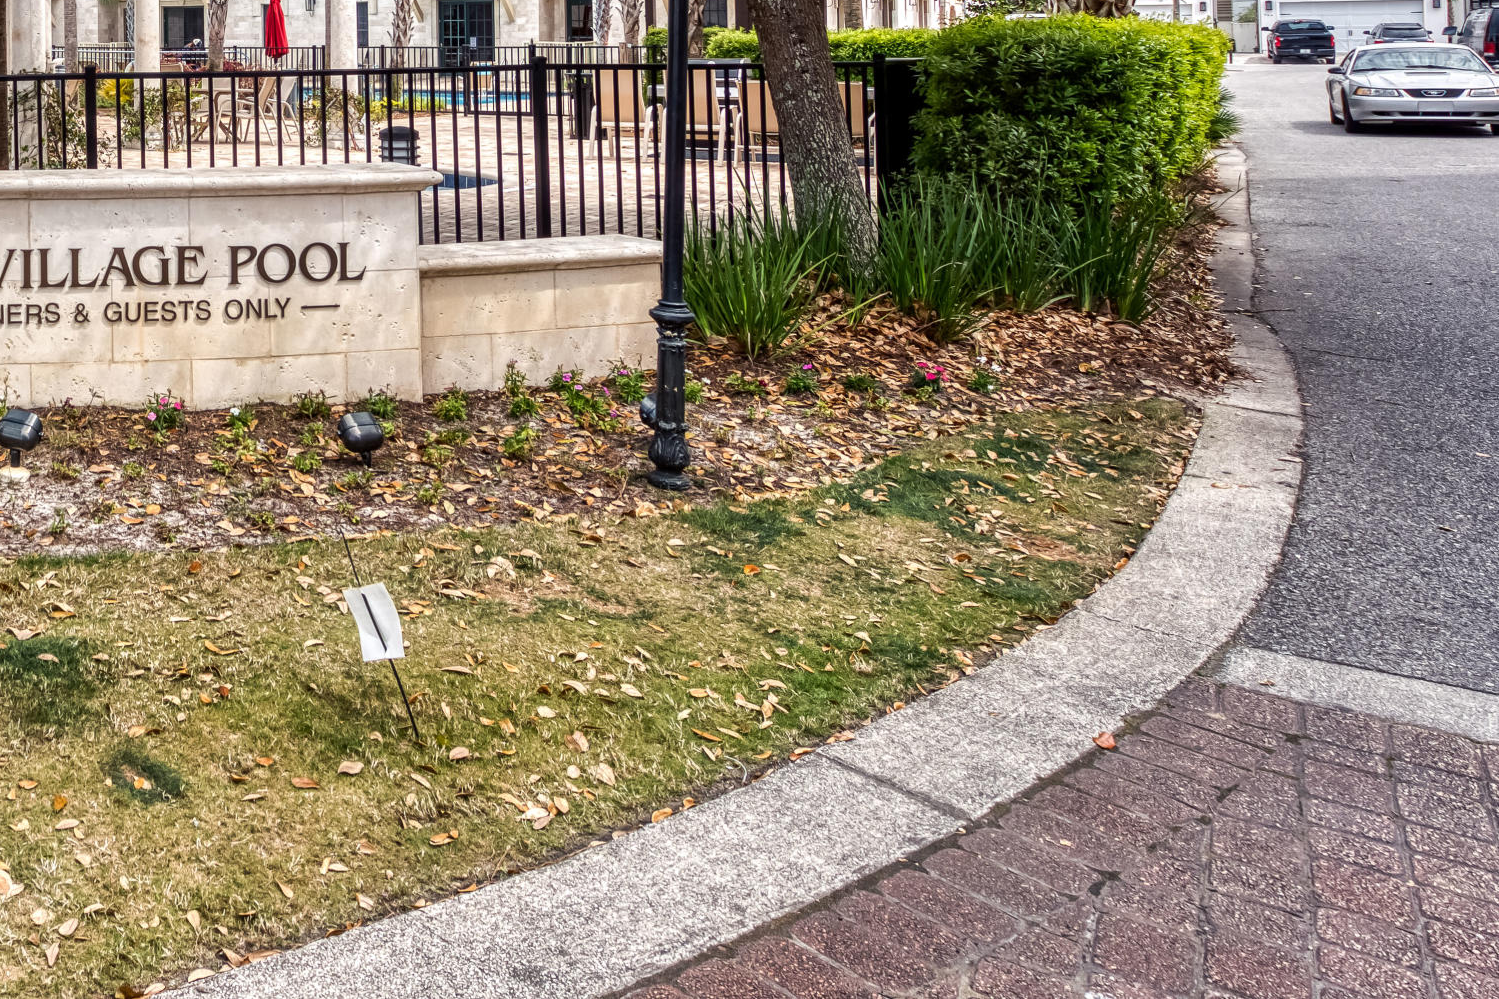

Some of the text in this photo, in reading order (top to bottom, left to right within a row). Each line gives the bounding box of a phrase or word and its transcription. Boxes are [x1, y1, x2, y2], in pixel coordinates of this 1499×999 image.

[228, 241, 367, 285] POOL
[73, 303, 91, 324] &
[104, 300, 212, 323] GUESTS
[224, 298, 292, 320] ONLY
